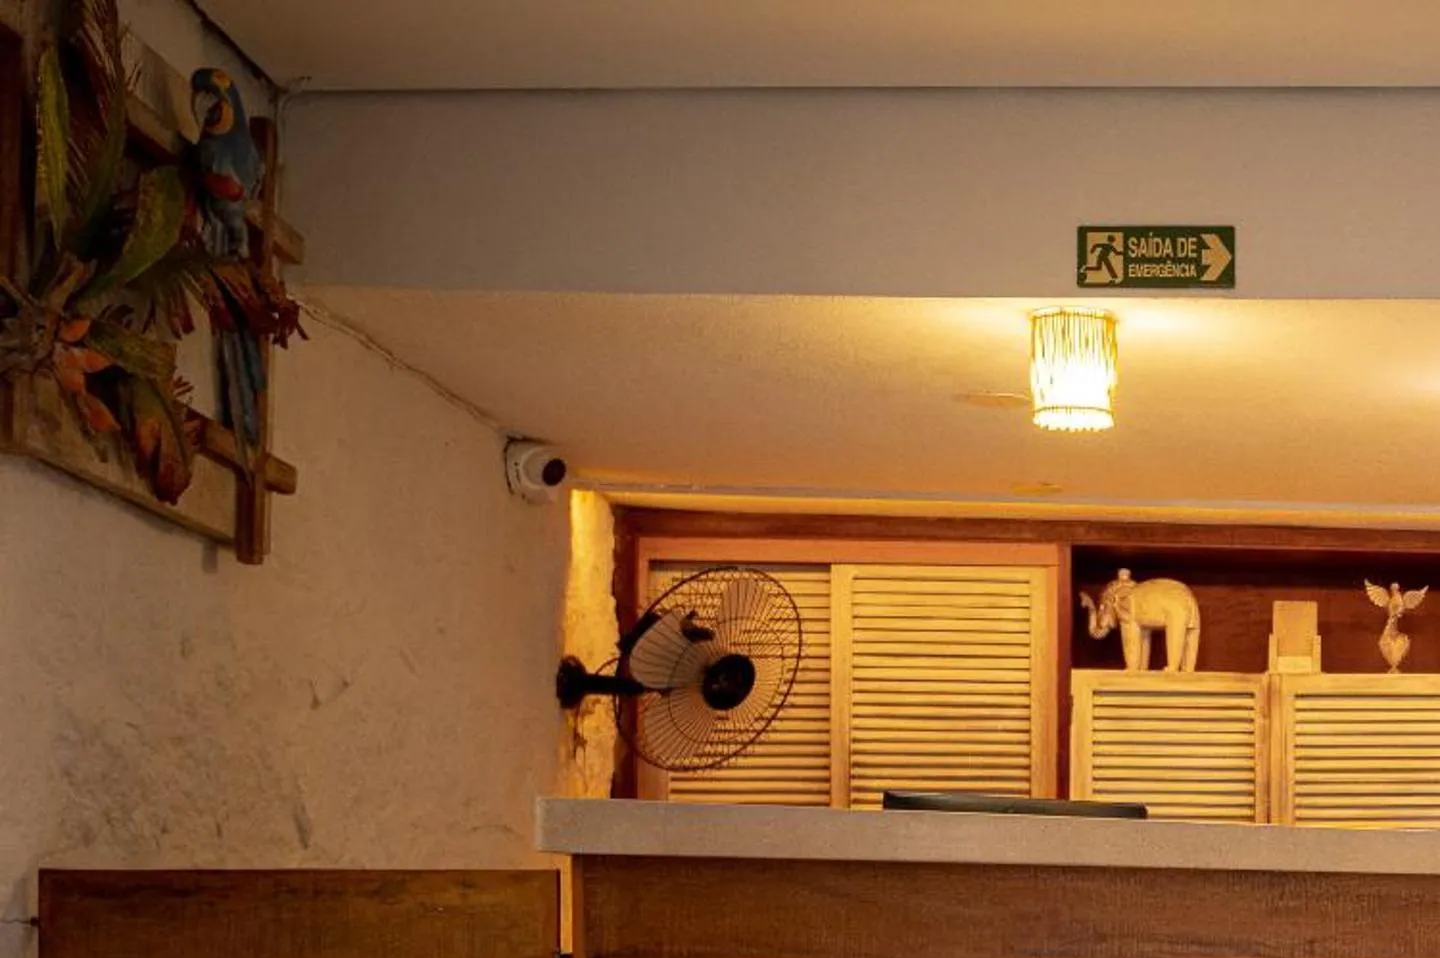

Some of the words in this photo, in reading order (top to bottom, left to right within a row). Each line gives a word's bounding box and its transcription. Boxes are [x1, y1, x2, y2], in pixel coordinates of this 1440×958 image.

[1128, 232, 1173, 258] SAÍDA
[1177, 237, 1197, 258] DE
[1128, 260, 1197, 277] EMERGÊNCIA
